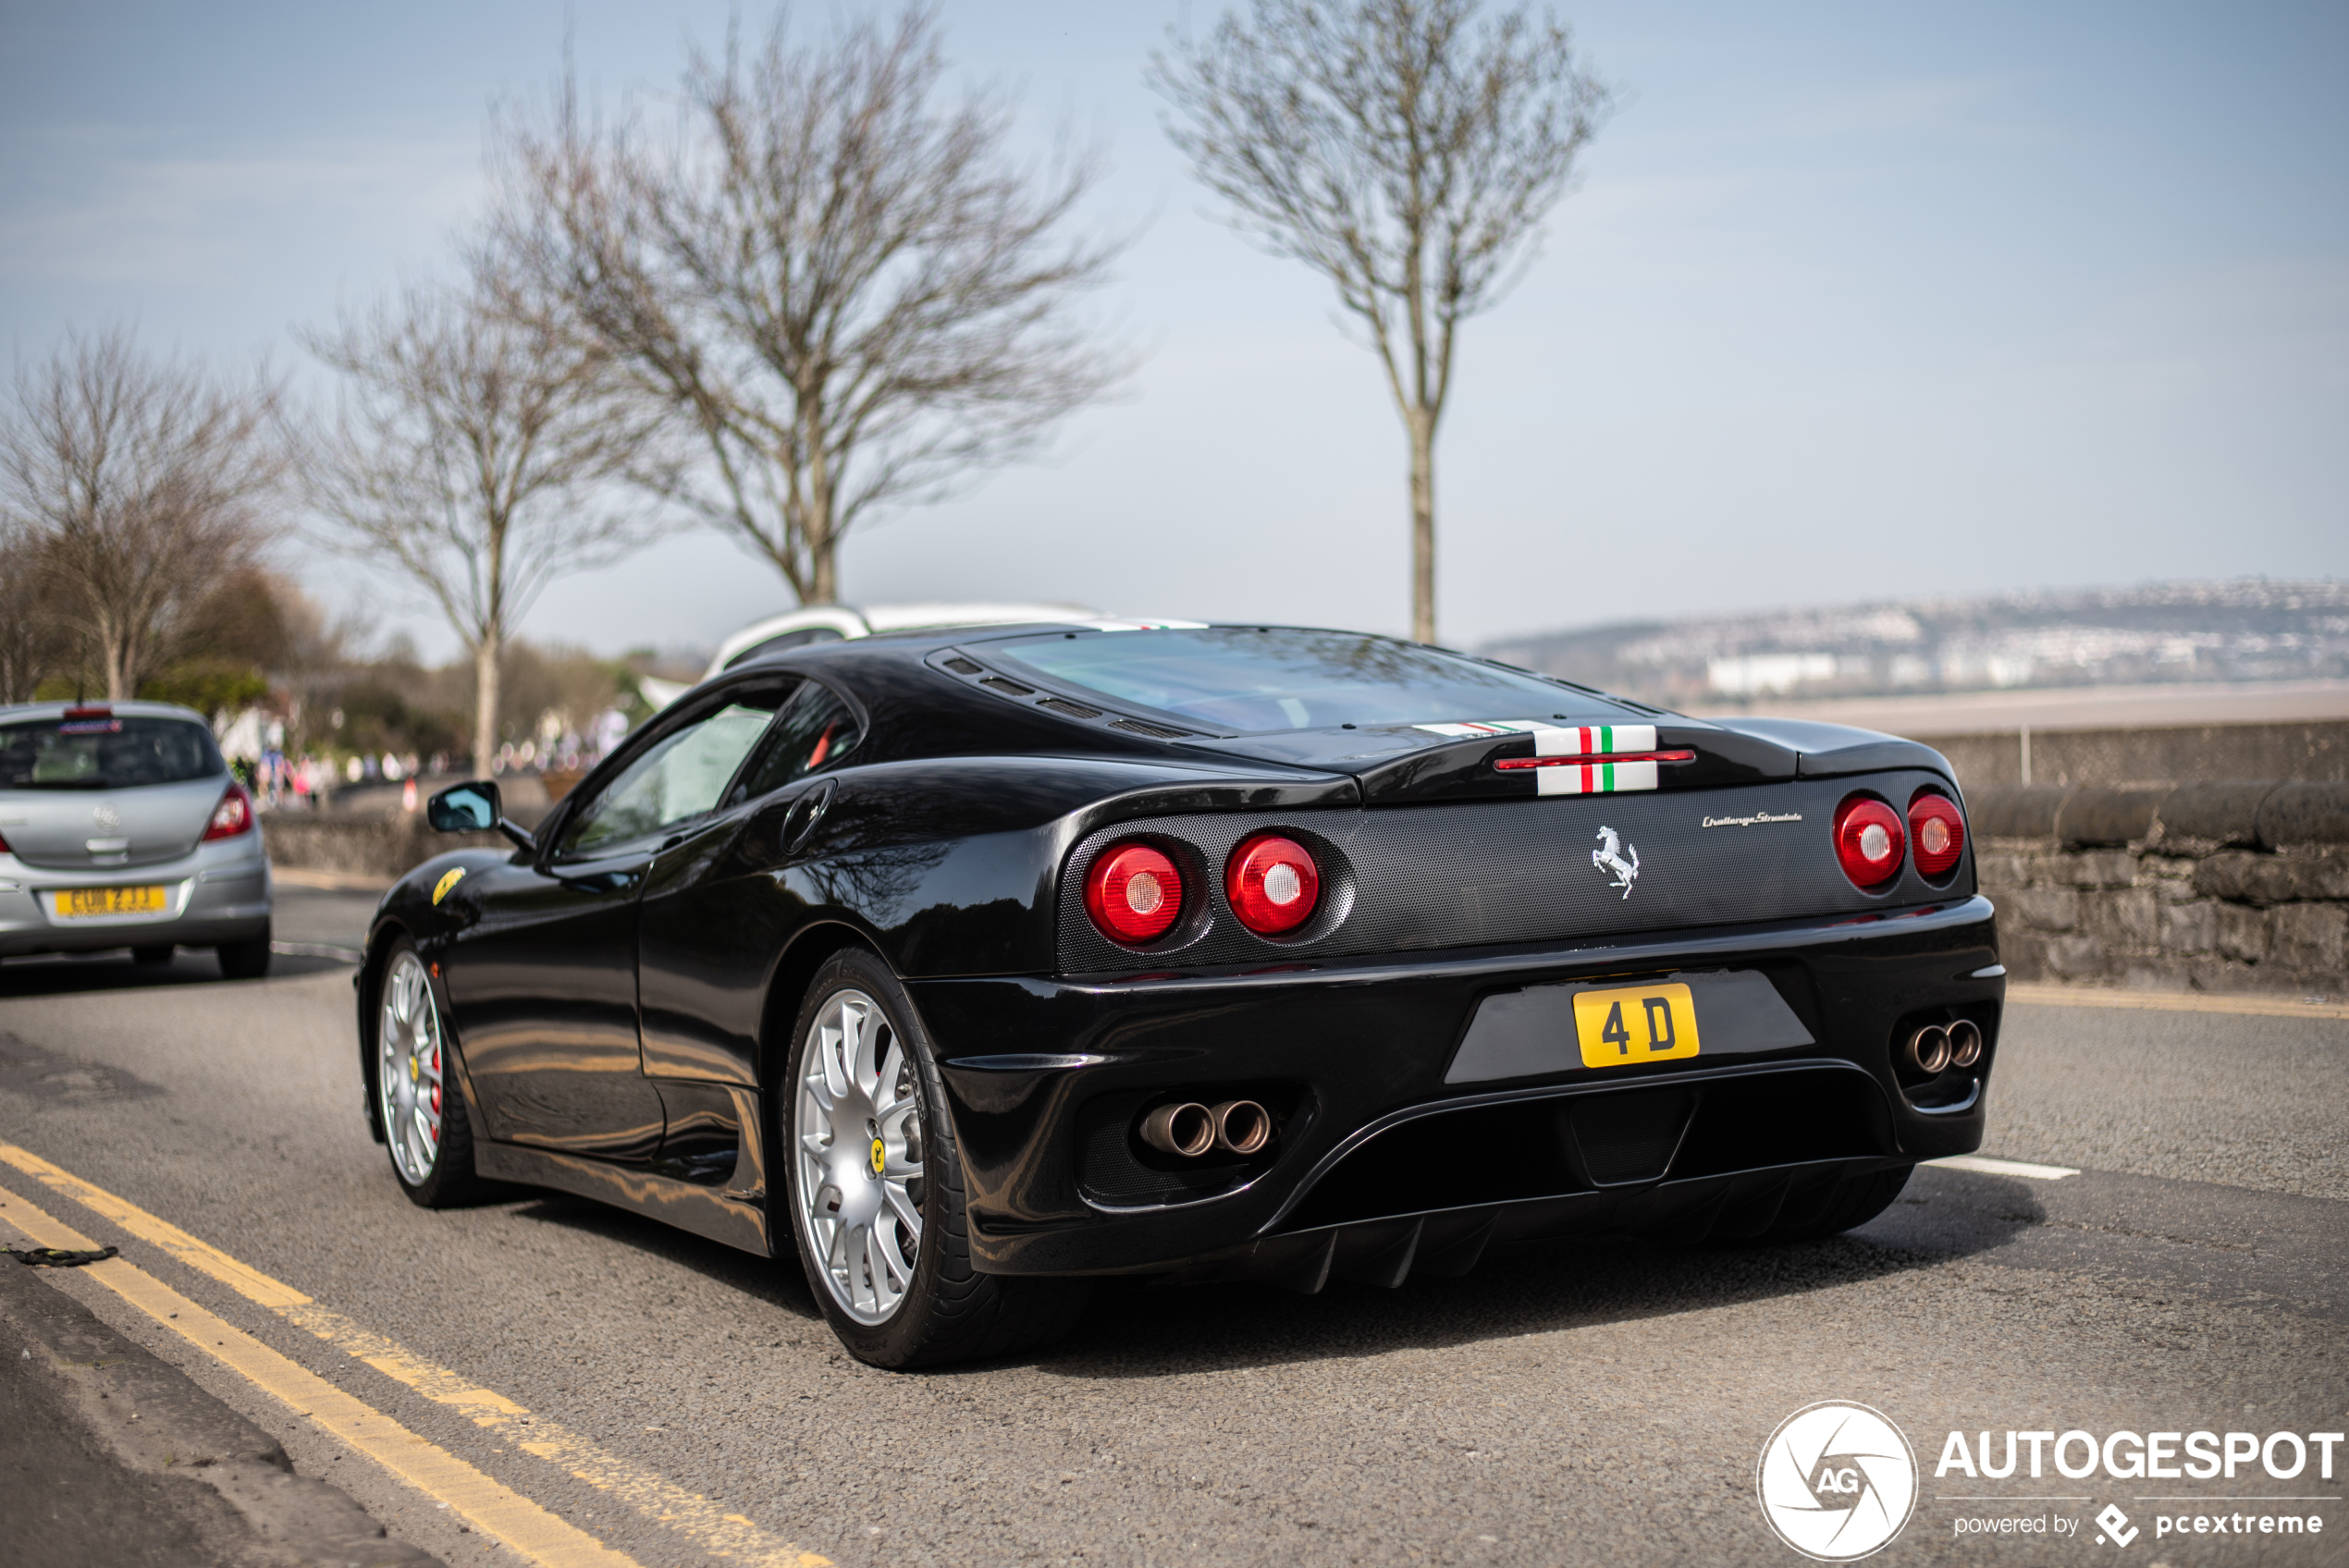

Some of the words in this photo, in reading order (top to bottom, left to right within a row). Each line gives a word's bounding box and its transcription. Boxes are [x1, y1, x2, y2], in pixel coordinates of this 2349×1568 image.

[1703, 816, 1756, 827] Challenge
[1756, 812, 1802, 822] Stradale
[1601, 1001, 1630, 1055] 4
[1642, 997, 1676, 1051] D
